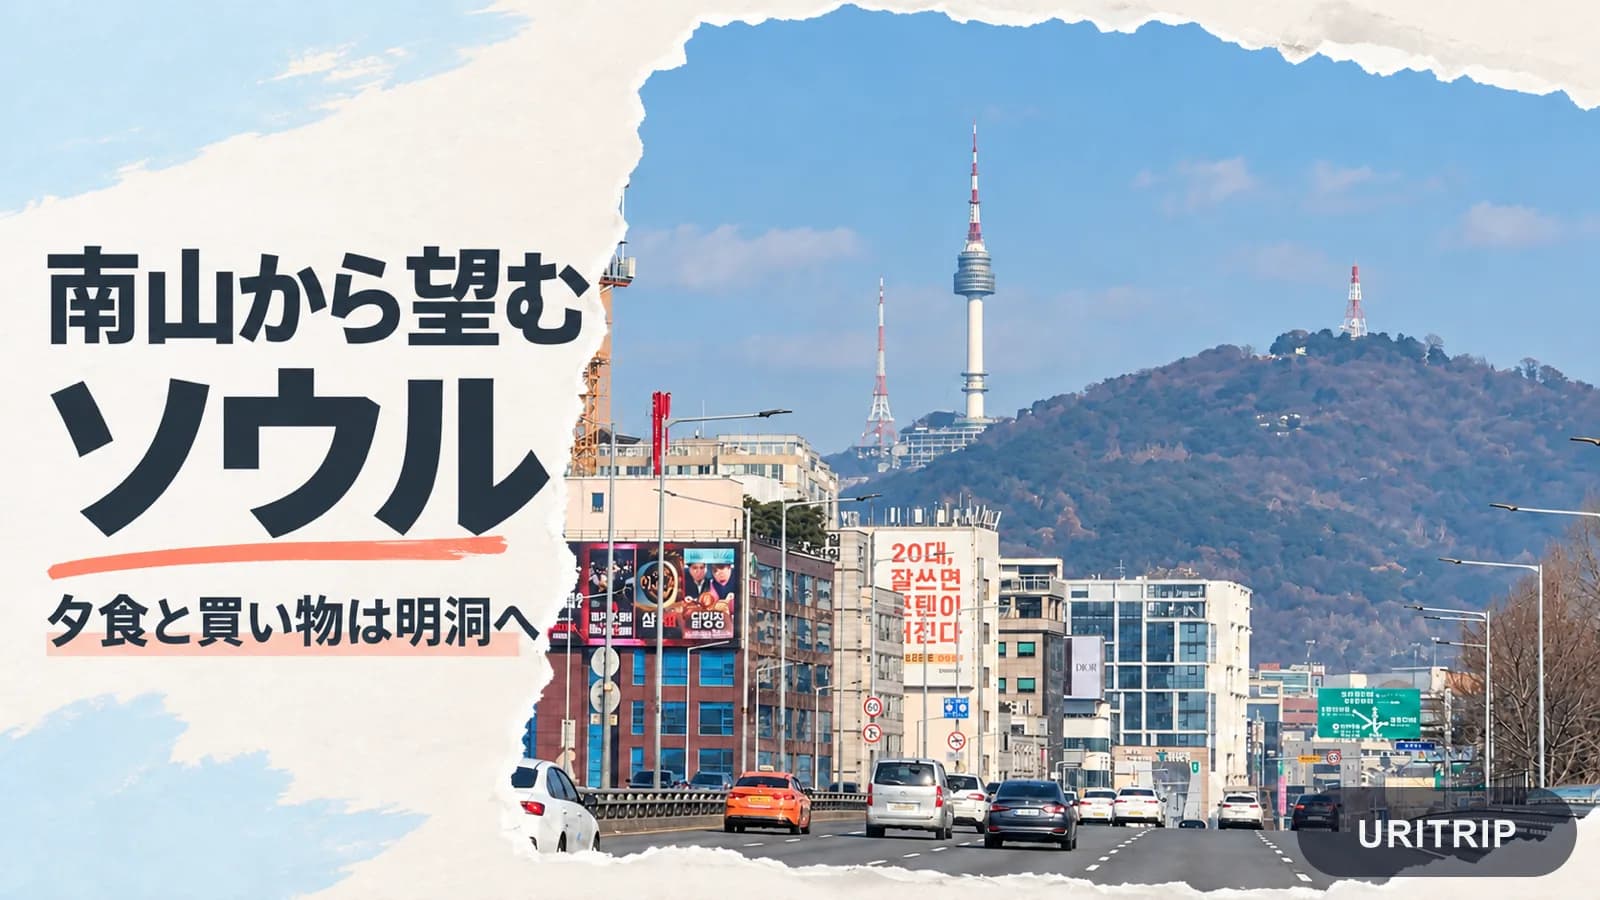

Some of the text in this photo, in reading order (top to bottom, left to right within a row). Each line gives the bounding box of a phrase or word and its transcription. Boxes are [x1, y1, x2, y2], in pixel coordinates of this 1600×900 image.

[891, 542, 953, 565] 20대,
[1076, 663, 1097, 672] DIOR
[867, 702, 879, 712] 60
